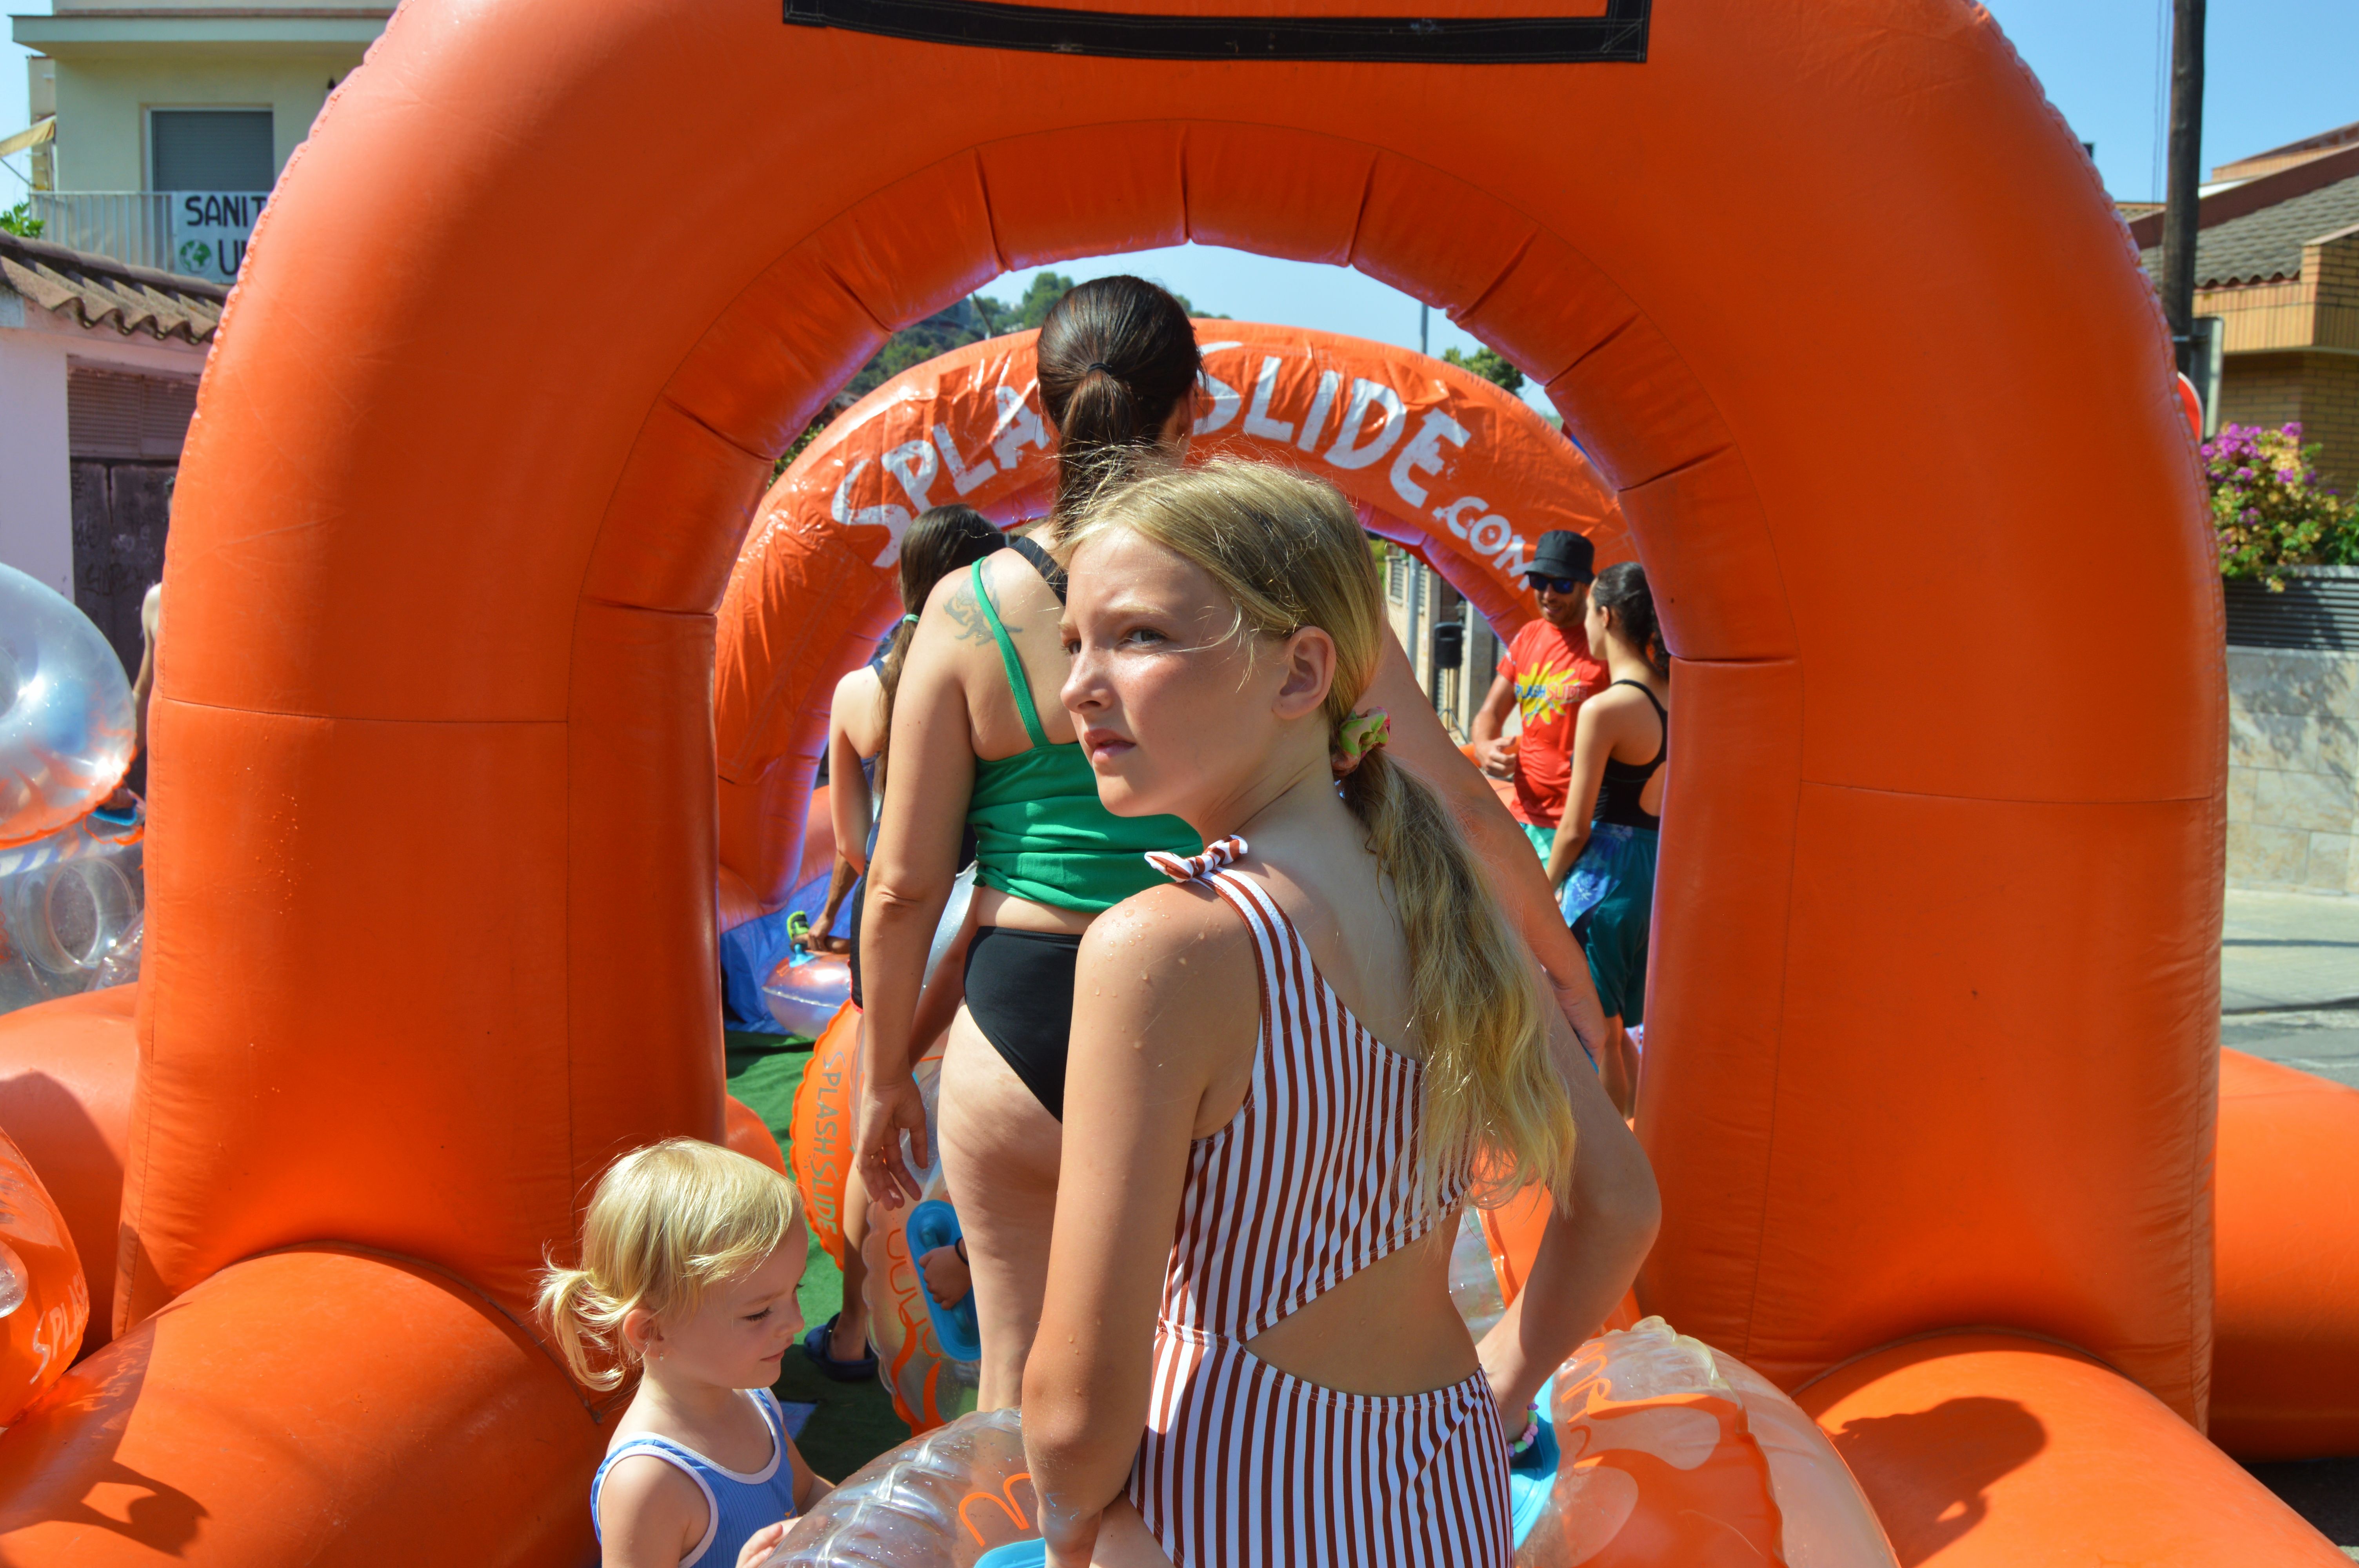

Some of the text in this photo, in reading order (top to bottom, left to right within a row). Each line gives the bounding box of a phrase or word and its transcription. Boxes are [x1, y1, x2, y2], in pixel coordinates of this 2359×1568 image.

[218, 239, 247, 276] U
[810, 1051, 846, 1234] SPLASH SLIDE
